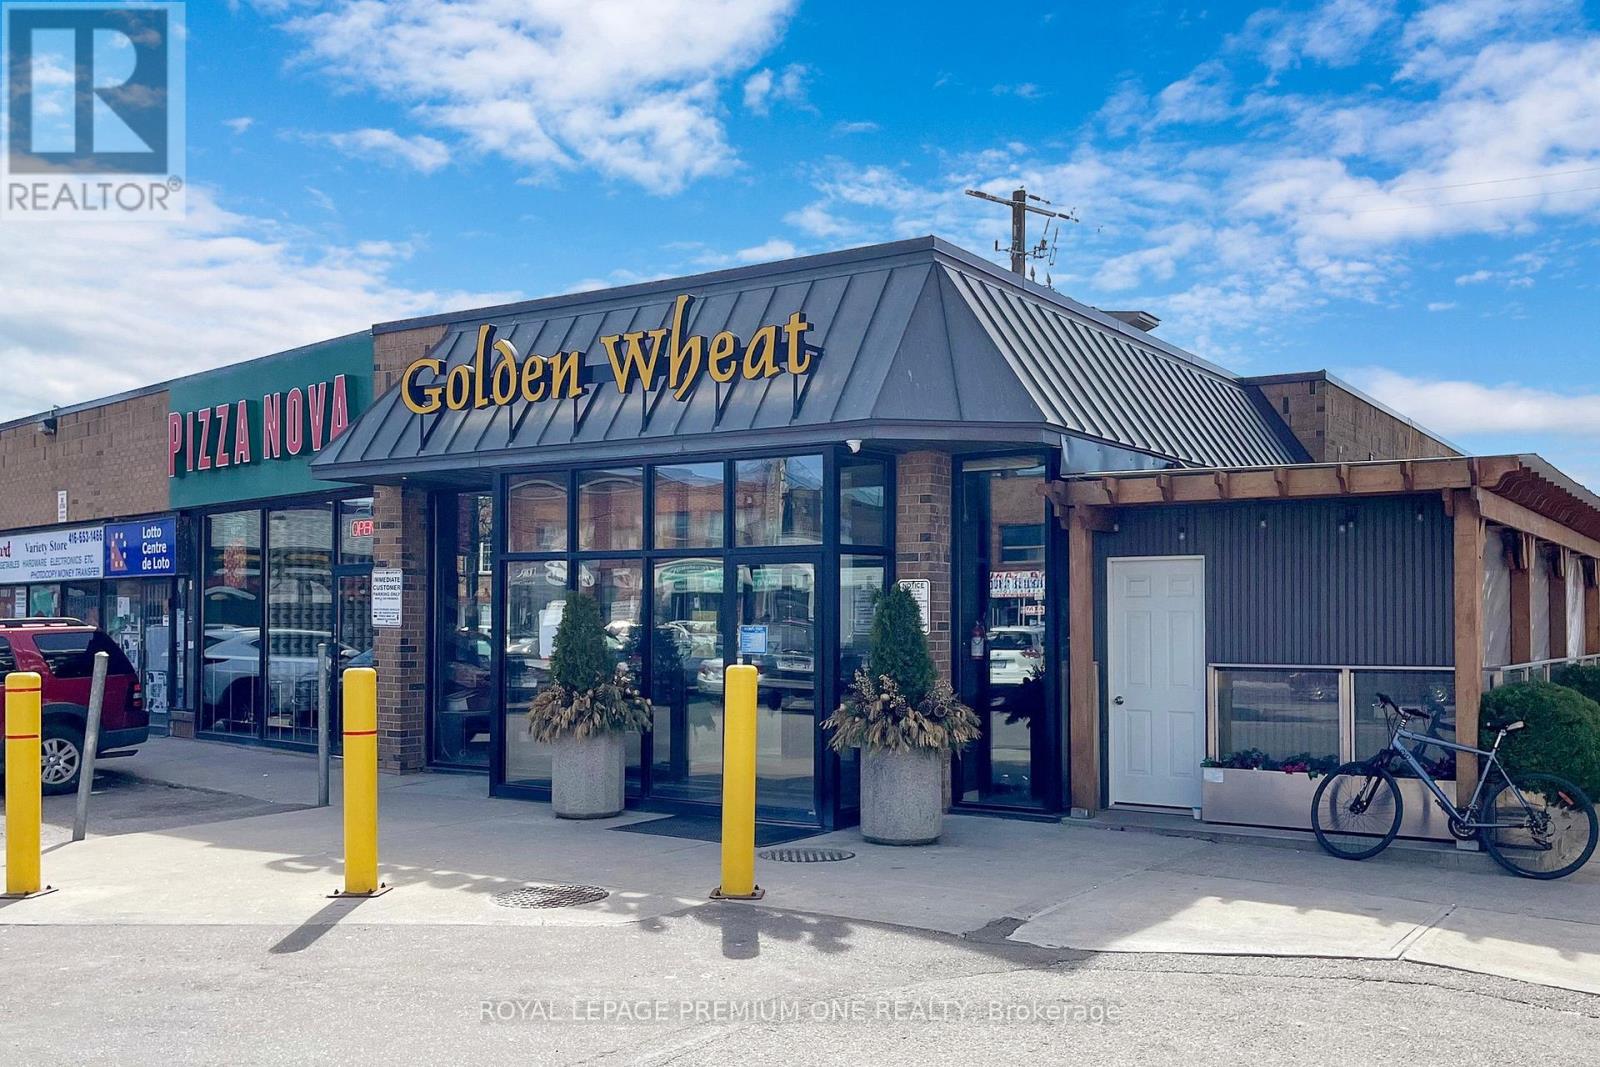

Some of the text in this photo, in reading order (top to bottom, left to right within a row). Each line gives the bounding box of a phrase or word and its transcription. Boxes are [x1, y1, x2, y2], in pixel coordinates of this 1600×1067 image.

[401, 294, 814, 415] Golden Wheat
[168, 373, 350, 478] PIZZA NOVA
[142, 525, 162, 539] Lotto
[25, 540, 68, 555] Variety Store
[142, 541, 167, 555] Centre
[22, 558, 47, 568] HARDWARE
[50, 555, 82, 566] ELECTRONICS
[142, 556, 170, 570] de Loto
[31, 566, 100, 579] PHOTOCOPY MONEY TRANSFER
